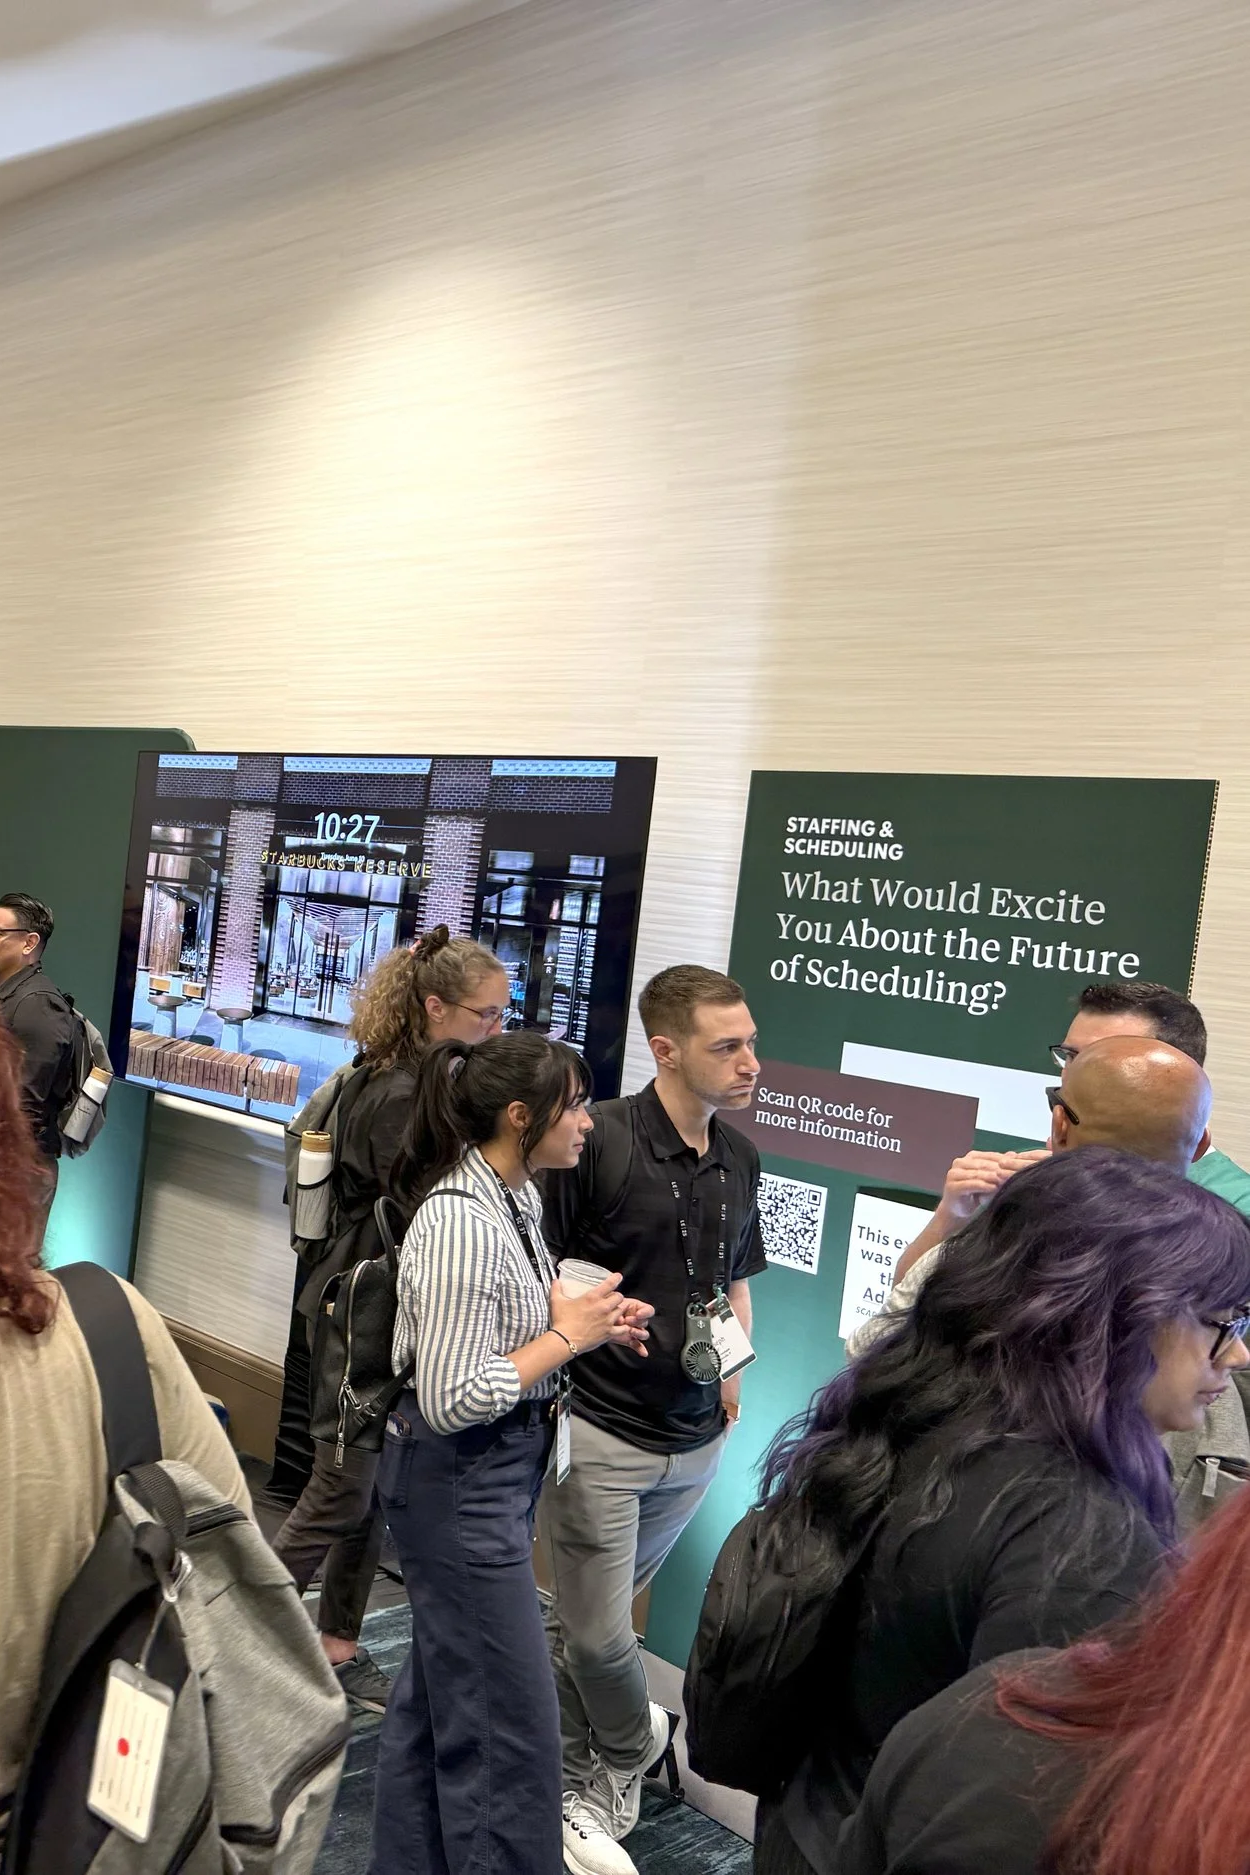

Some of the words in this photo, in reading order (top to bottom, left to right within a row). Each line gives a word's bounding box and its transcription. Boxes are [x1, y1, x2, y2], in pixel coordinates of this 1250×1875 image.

[314, 811, 381, 844] 10:27
[786, 816, 876, 838] STAFFING
[878, 821, 895, 839] &
[260, 850, 346, 872] STARBUCKS
[353, 858, 433, 879] RESERVE
[783, 837, 904, 861] SCHEDULING
[781, 870, 864, 905] What
[869, 880, 981, 915] Would
[987, 887, 1107, 926] Excite
[776, 912, 832, 944] You
[836, 917, 937, 957] About
[942, 927, 1001, 964] the
[1007, 935, 1141, 979] Future
[769, 953, 805, 984] of
[805, 957, 1007, 1017] Scheduling?
[757, 1087, 795, 1109] Scan
[797, 1095, 823, 1115] QR
[824, 1102, 865, 1123] code
[866, 1106, 894, 1129] for
[754, 1109, 797, 1130] more
[798, 1115, 902, 1153] information
[857, 1225, 890, 1246] This
[860, 1248, 892, 1267] was
